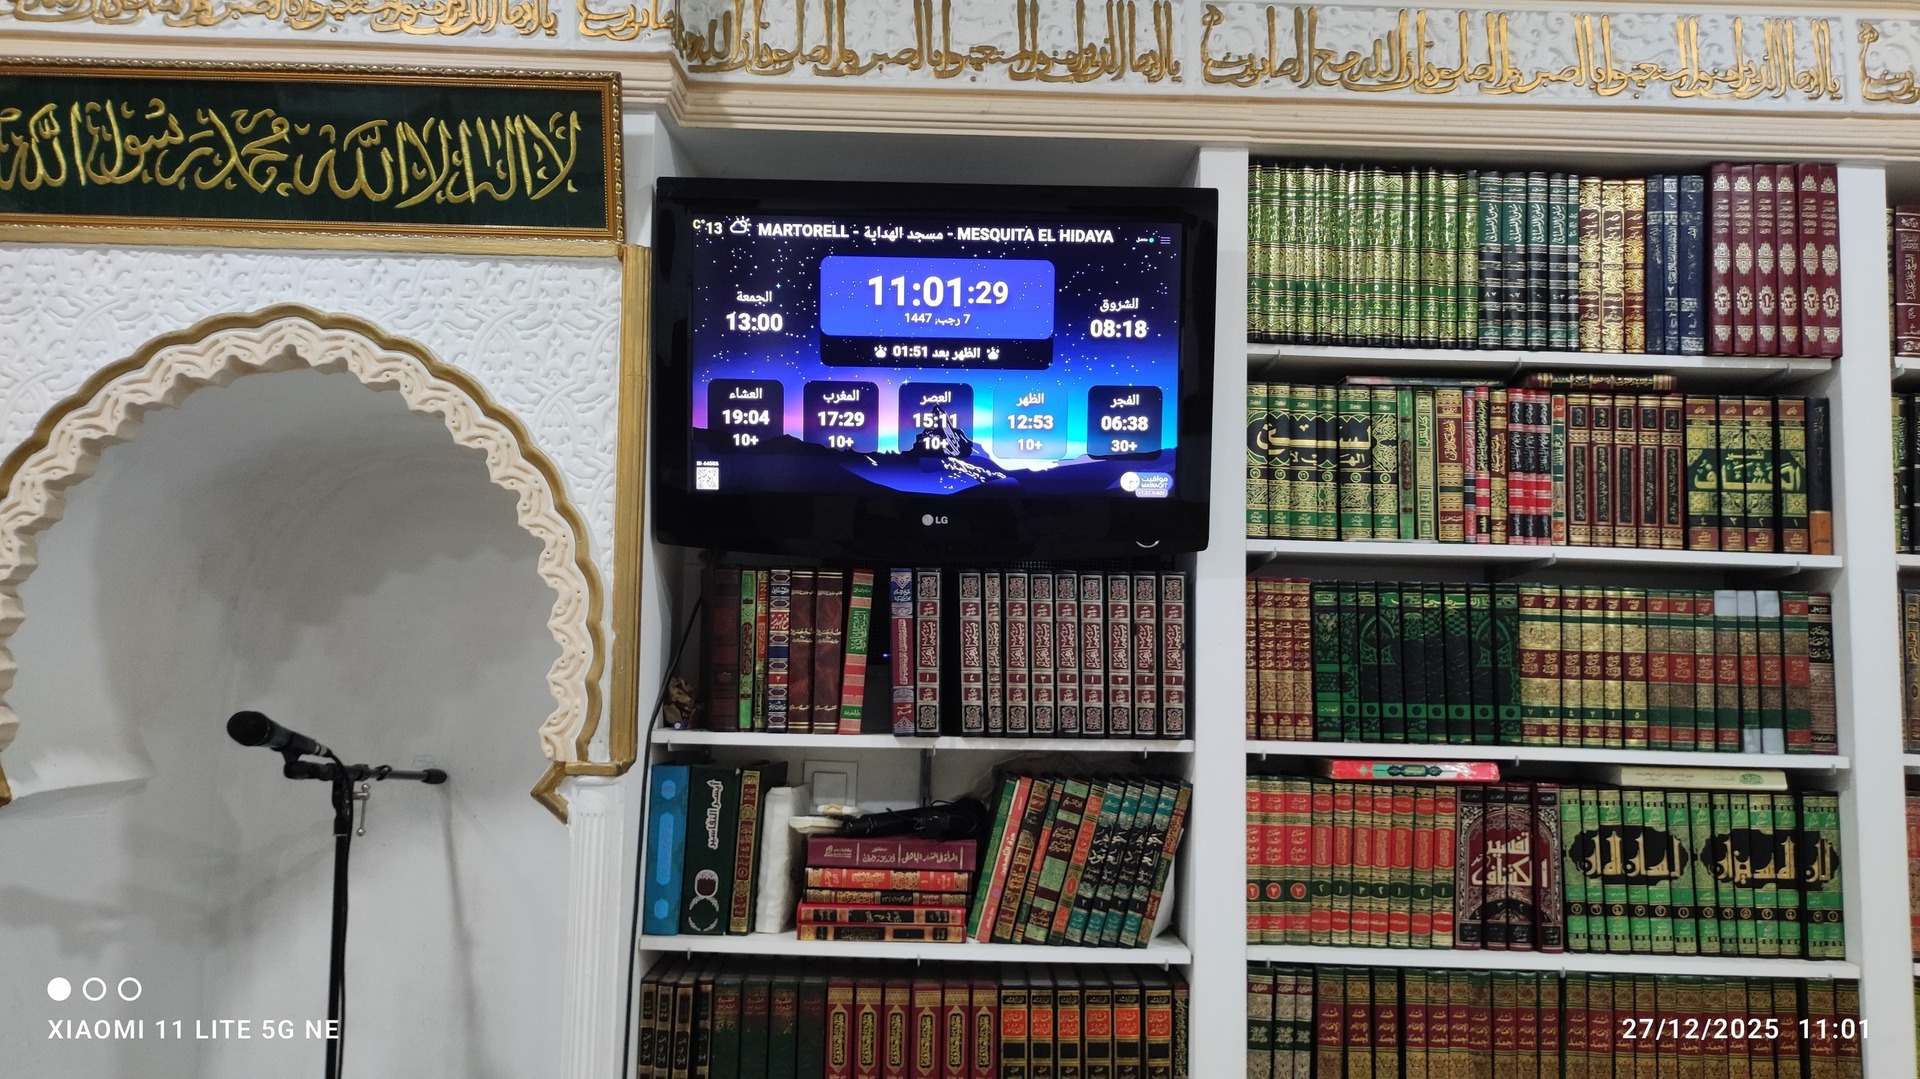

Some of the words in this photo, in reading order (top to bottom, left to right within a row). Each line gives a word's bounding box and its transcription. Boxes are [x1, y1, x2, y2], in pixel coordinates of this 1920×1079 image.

[758, 223, 849, 237] MARTORELL
[863, 226, 903, 243] الهداية
[907, 229, 944, 243] مسجد
[957, 227, 1035, 242] MESQUITA
[1038, 229, 1055, 242] EL
[1059, 229, 1114, 243] HIDAYA
[736, 291, 773, 305] الجمعة
[868, 275, 1009, 308] 11:01:29
[1100, 298, 1139, 313] الشروق
[726, 312, 783, 331] 13:00
[905, 313, 933, 324] 1447
[963, 313, 971, 324] 7
[1090, 319, 1149, 338] 08:18
[893, 346, 928, 358] 01:51
[932, 350, 950, 360] بعد
[952, 348, 981, 361] الظهر
[729, 388, 764, 400] العشاء
[823, 390, 860, 403] المغرب
[920, 391, 951, 406] العصر
[1016, 393, 1045, 407] الظهر
[1110, 394, 1140, 408] الفجر
[722, 409, 770, 425] 19:04
[817, 411, 865, 427] 17:29
[912, 413, 958, 428] 15:11
[1007, 415, 1054, 430] 12:53
[1101, 416, 1149, 431] 06:38
[732, 433, 759, 446] 10+
[828, 435, 854, 448] 10+
[1017, 438, 1043, 451] 10+
[1111, 439, 1138, 452] 30+
[935, 515, 948, 525] LG
